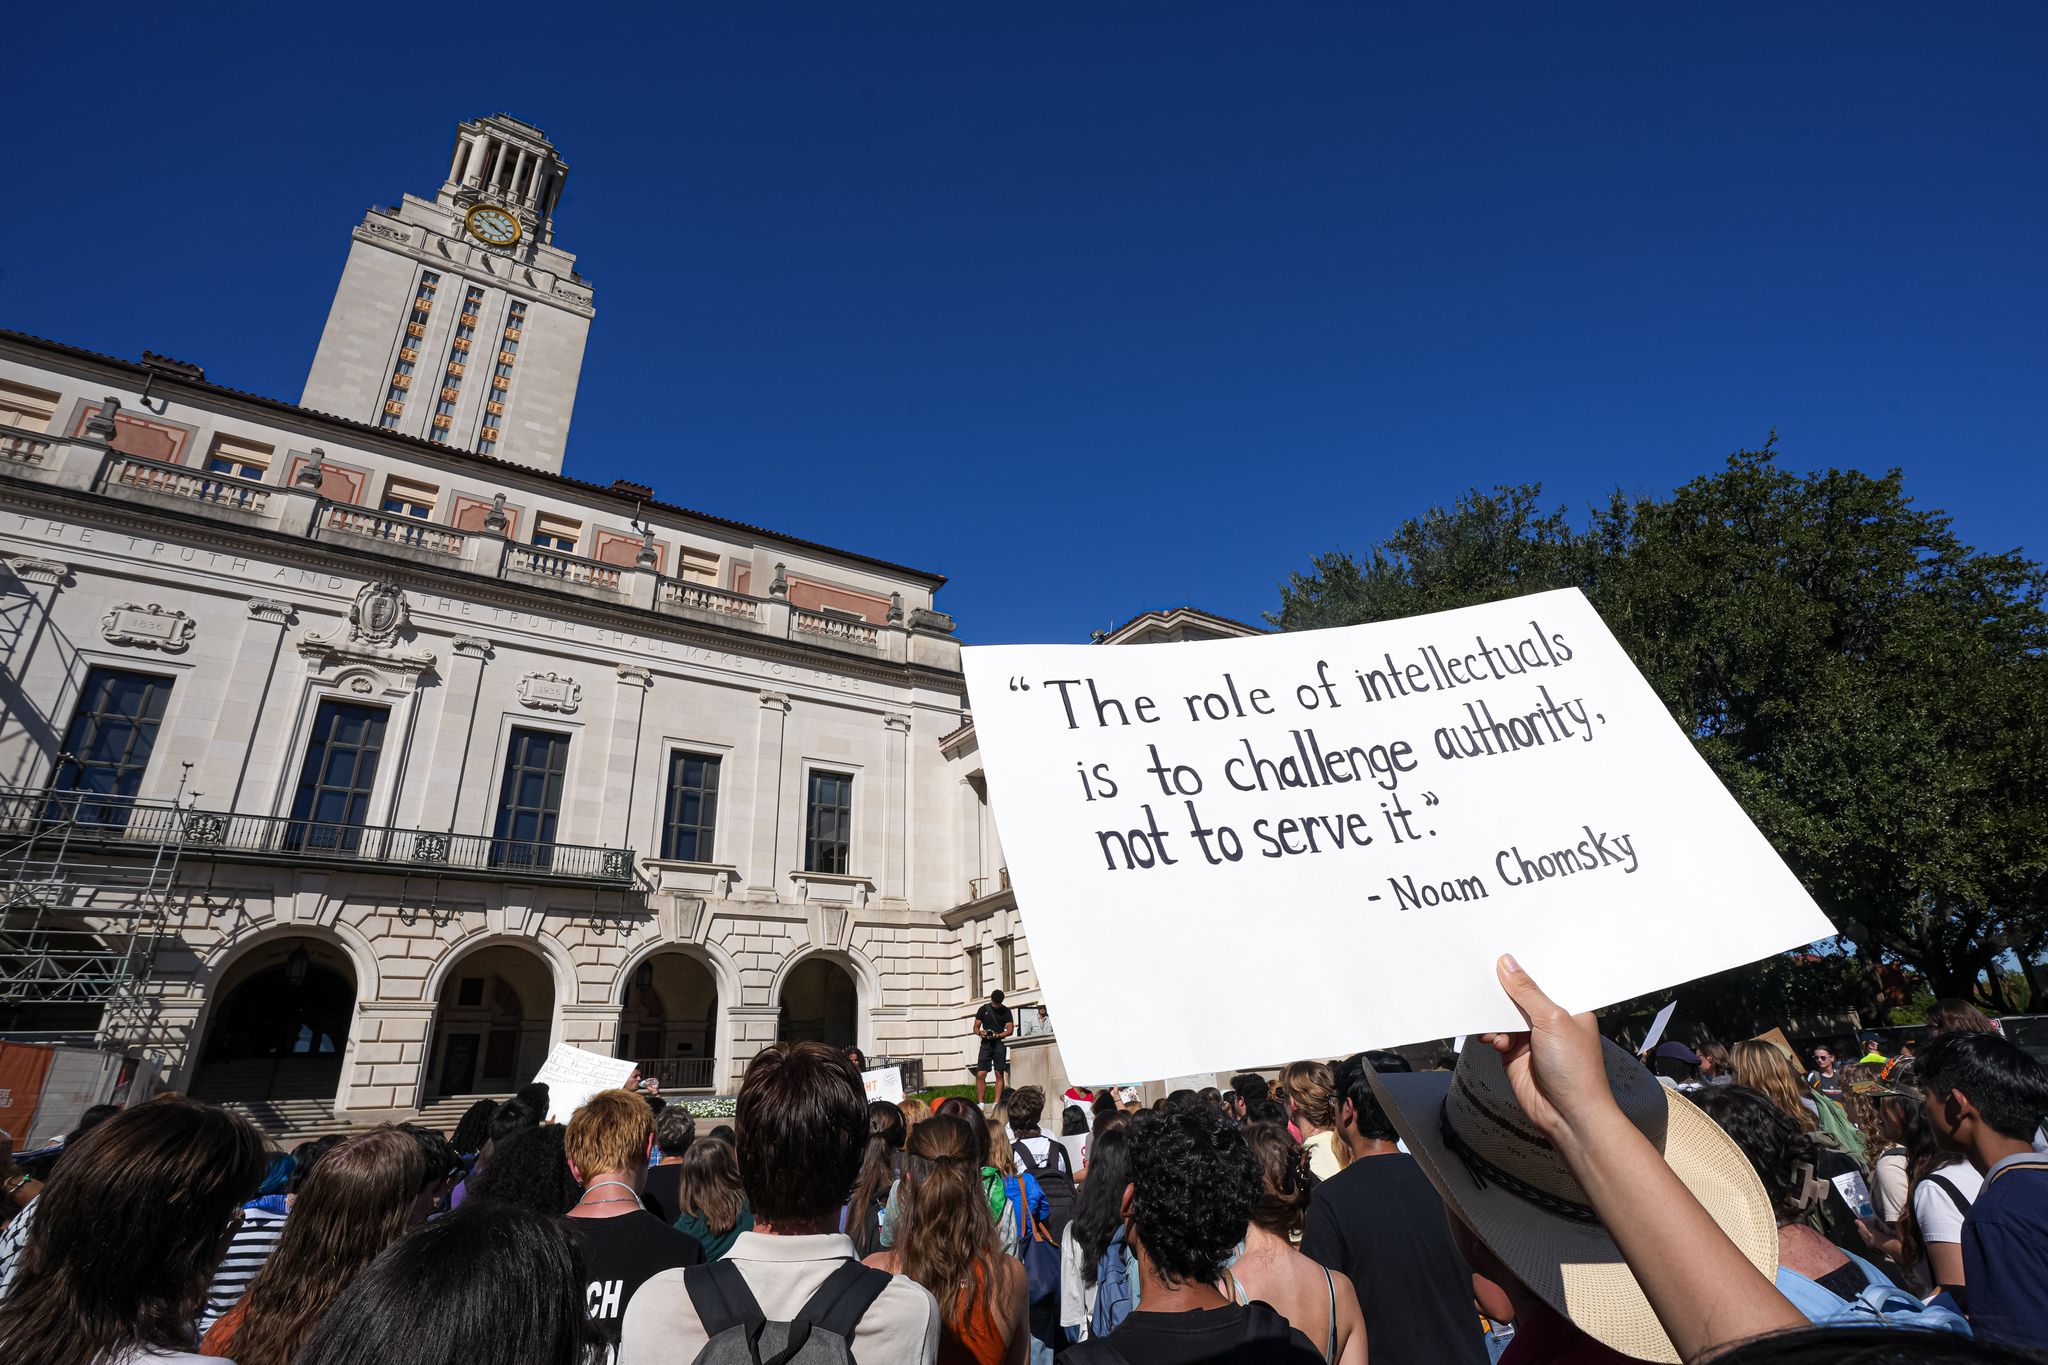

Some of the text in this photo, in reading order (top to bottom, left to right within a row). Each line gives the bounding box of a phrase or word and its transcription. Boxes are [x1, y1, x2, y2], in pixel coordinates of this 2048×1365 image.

[18, 515, 95, 543] THE
[127, 536, 249, 572] TRUTH
[273, 567, 343, 590] AND
[420, 594, 471, 615] THE
[492, 608, 577, 636] TRUTH
[596, 629, 669, 654] SHALL
[685, 646, 744, 668] MAKE
[759, 660, 798, 678] YOU
[1184, 674, 1275, 721] role
[1297, 660, 1341, 710] of
[1355, 621, 1573, 702] intellectuals
[1077, 686, 1606, 802] is to challenge authority,
[1096, 805, 1179, 871] not
[1184, 801, 1244, 865] to
[1254, 814, 1374, 858] serve
[1496, 826, 1638, 886] Chomsky
